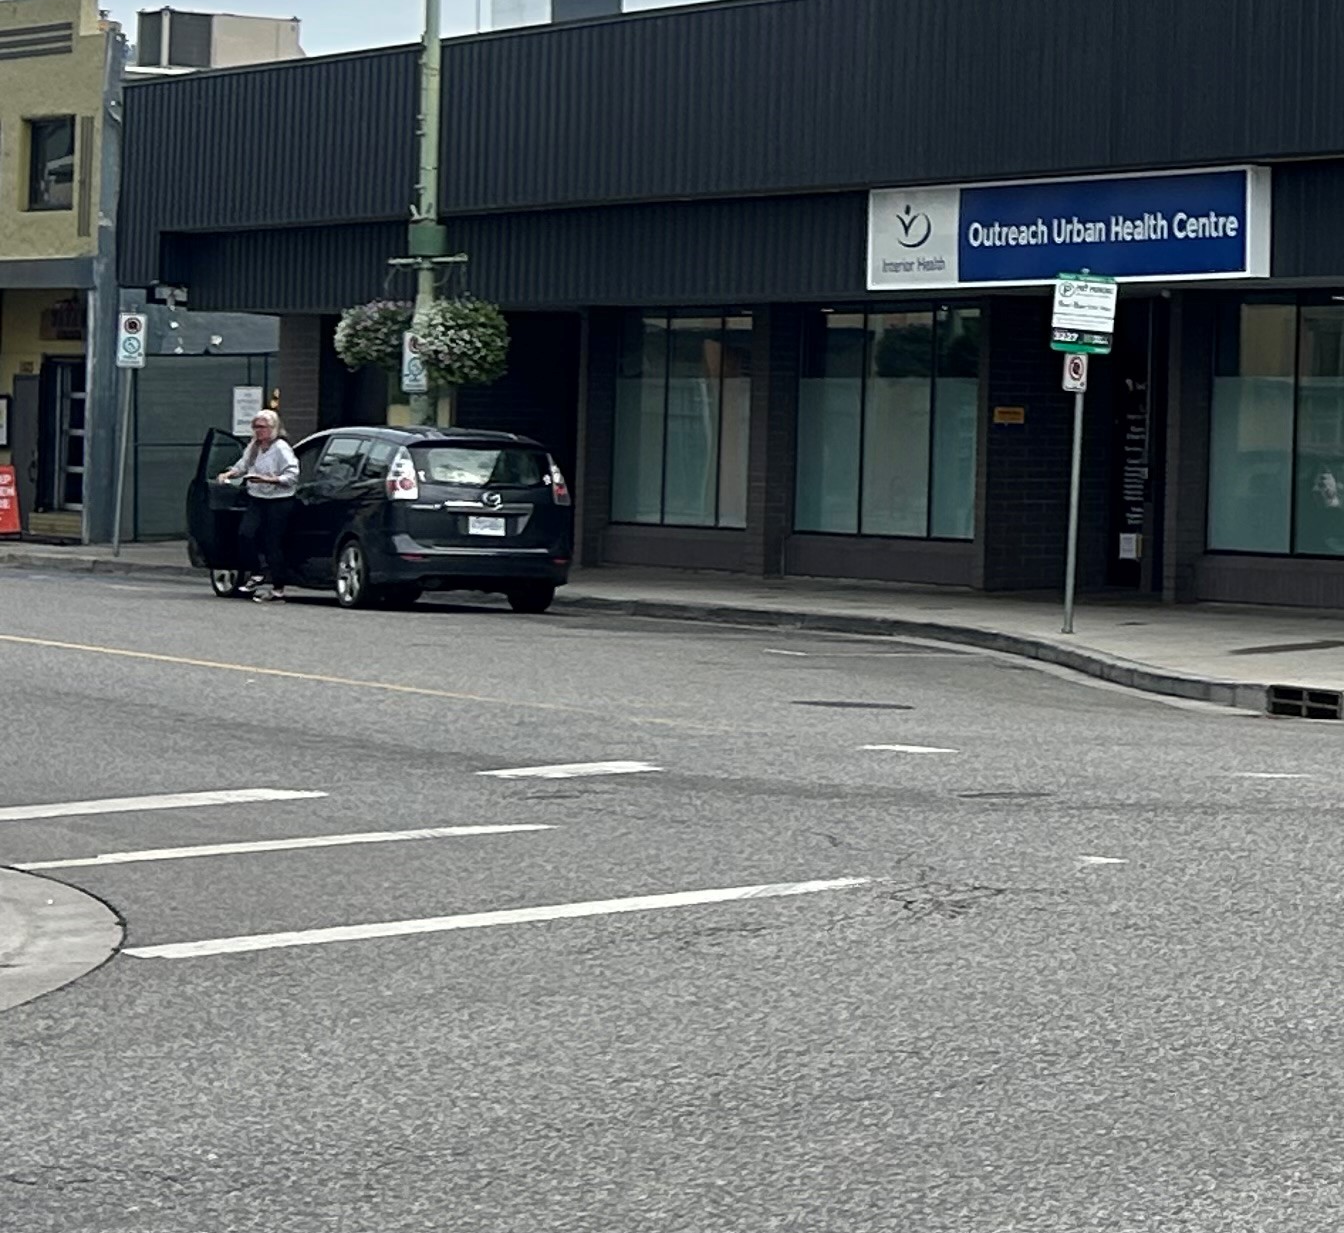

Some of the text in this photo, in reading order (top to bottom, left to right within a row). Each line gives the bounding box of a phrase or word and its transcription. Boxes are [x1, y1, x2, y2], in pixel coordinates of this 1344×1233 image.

[968, 211, 1239, 247] Outreach Urban Health Centre
